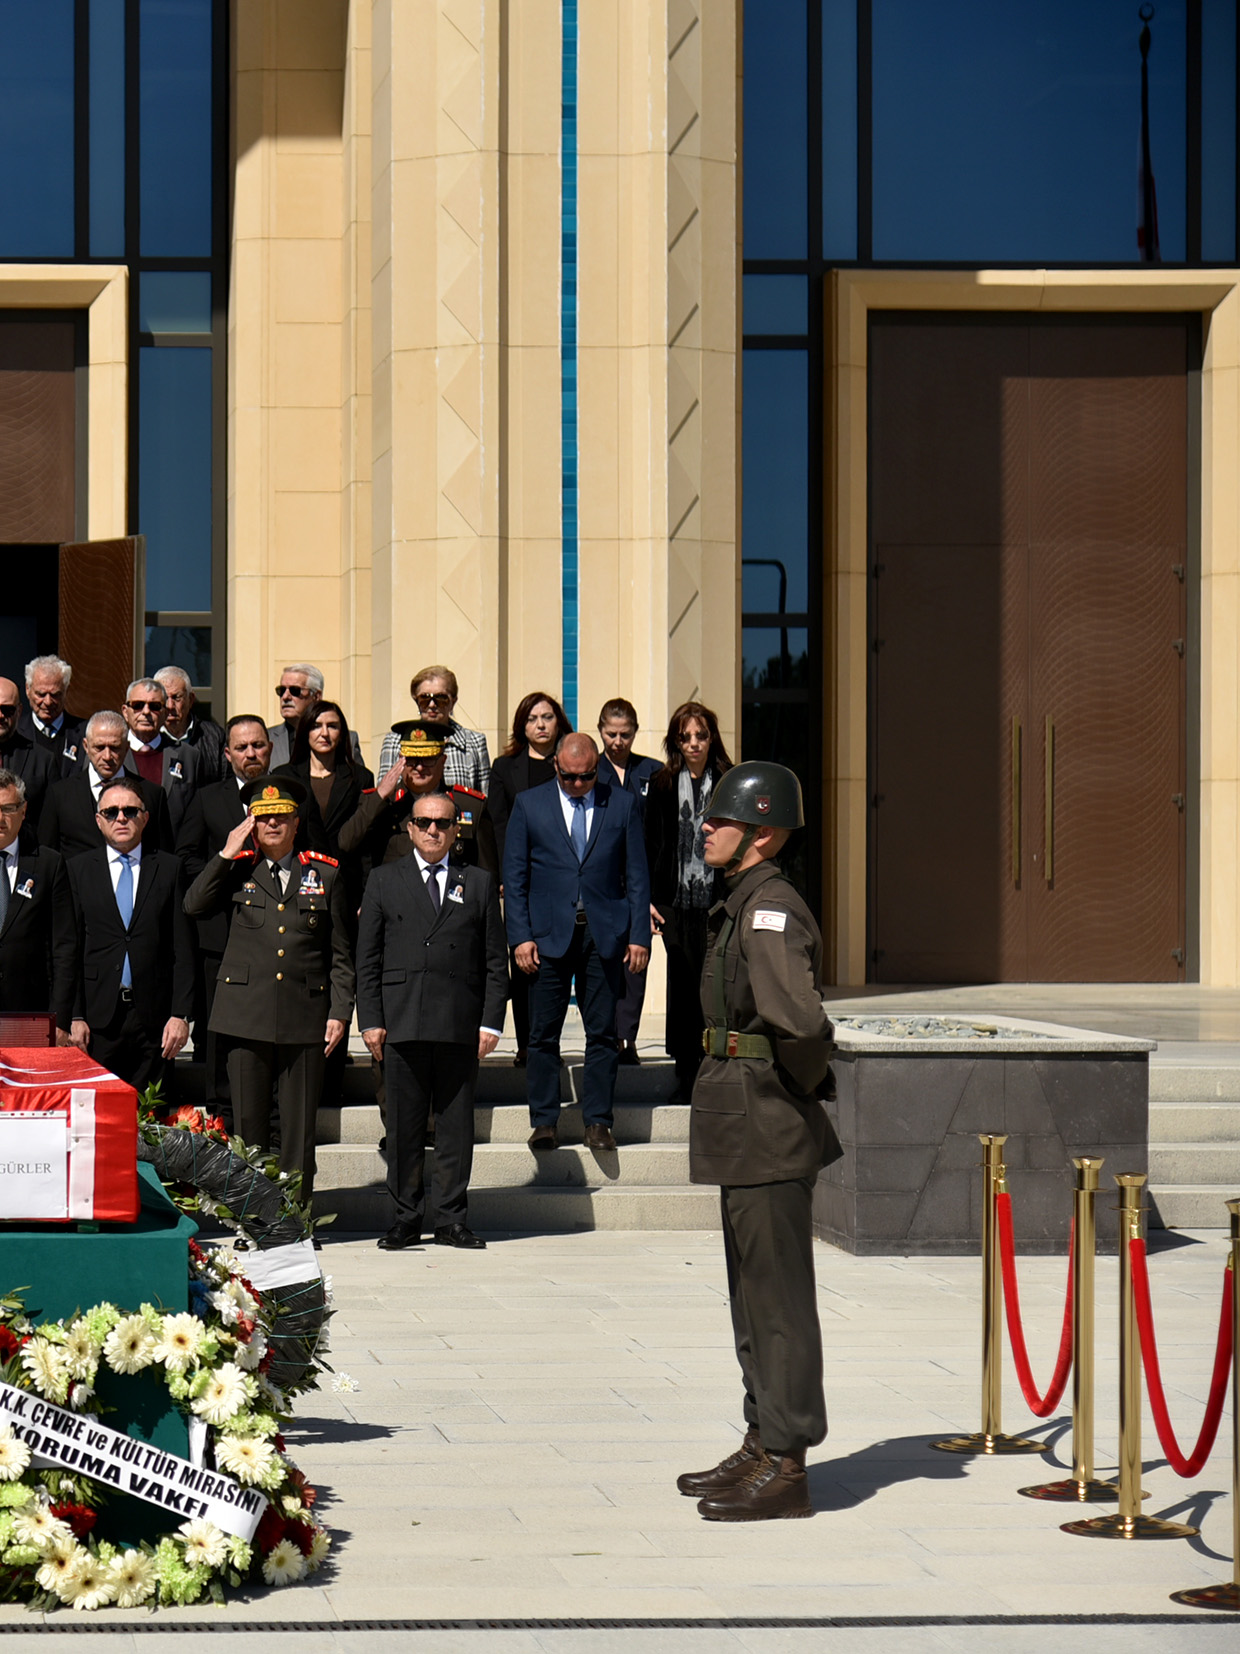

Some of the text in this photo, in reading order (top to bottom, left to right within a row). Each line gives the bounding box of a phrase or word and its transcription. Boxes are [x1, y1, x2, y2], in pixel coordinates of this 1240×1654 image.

[10, 1420, 209, 1518] KORUMA VAKFI
[30, 1402, 87, 1441] ÇEVRE
[88, 1428, 108, 1450] ve
[109, 1433, 178, 1481] KÜLTÜR
[178, 1465, 262, 1516] MİRASINI
